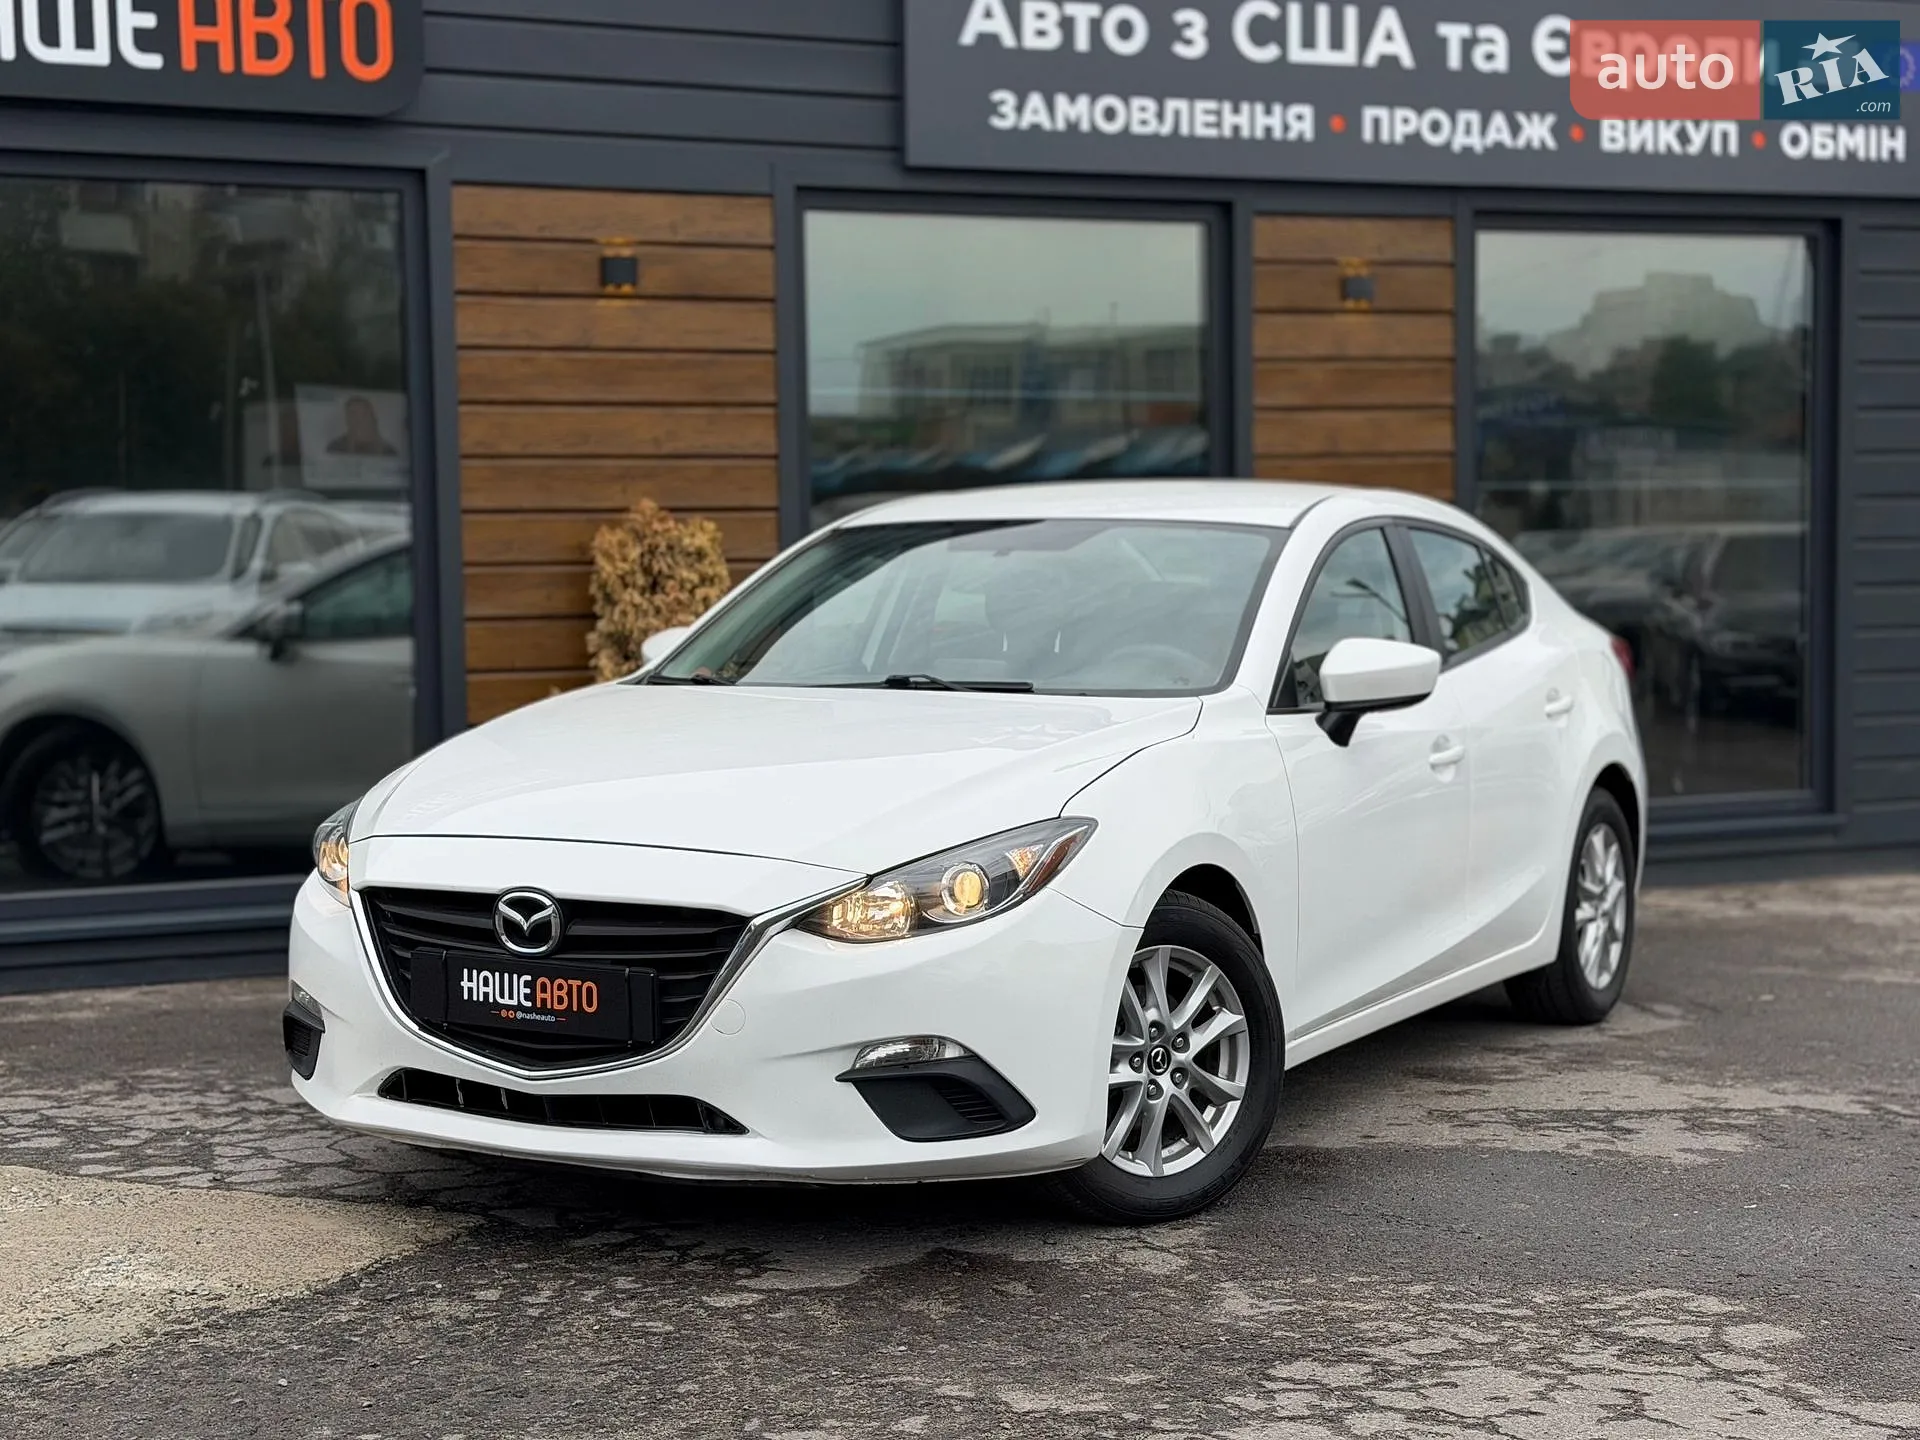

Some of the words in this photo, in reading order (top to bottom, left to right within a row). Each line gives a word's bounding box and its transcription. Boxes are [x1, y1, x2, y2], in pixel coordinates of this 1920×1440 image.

[0, 0, 164, 70] ШЕ
[958, 0, 1150, 56] Авто
[1171, 8, 1209, 59] з
[1231, 0, 1416, 69] США
[1436, 20, 1510, 75] та
[989, 89, 1315, 142] ЗАМОВЛЕННЯ
[1361, 105, 1559, 155] ПРОДАЖ
[1601, 119, 1740, 157] ВИКУП
[1779, 121, 1907, 163] ОБМІН
[461, 968, 532, 1007] НАШЕ
[536, 976, 598, 1013] АВТО
[516, 1010, 556, 1022] @nasheauto
